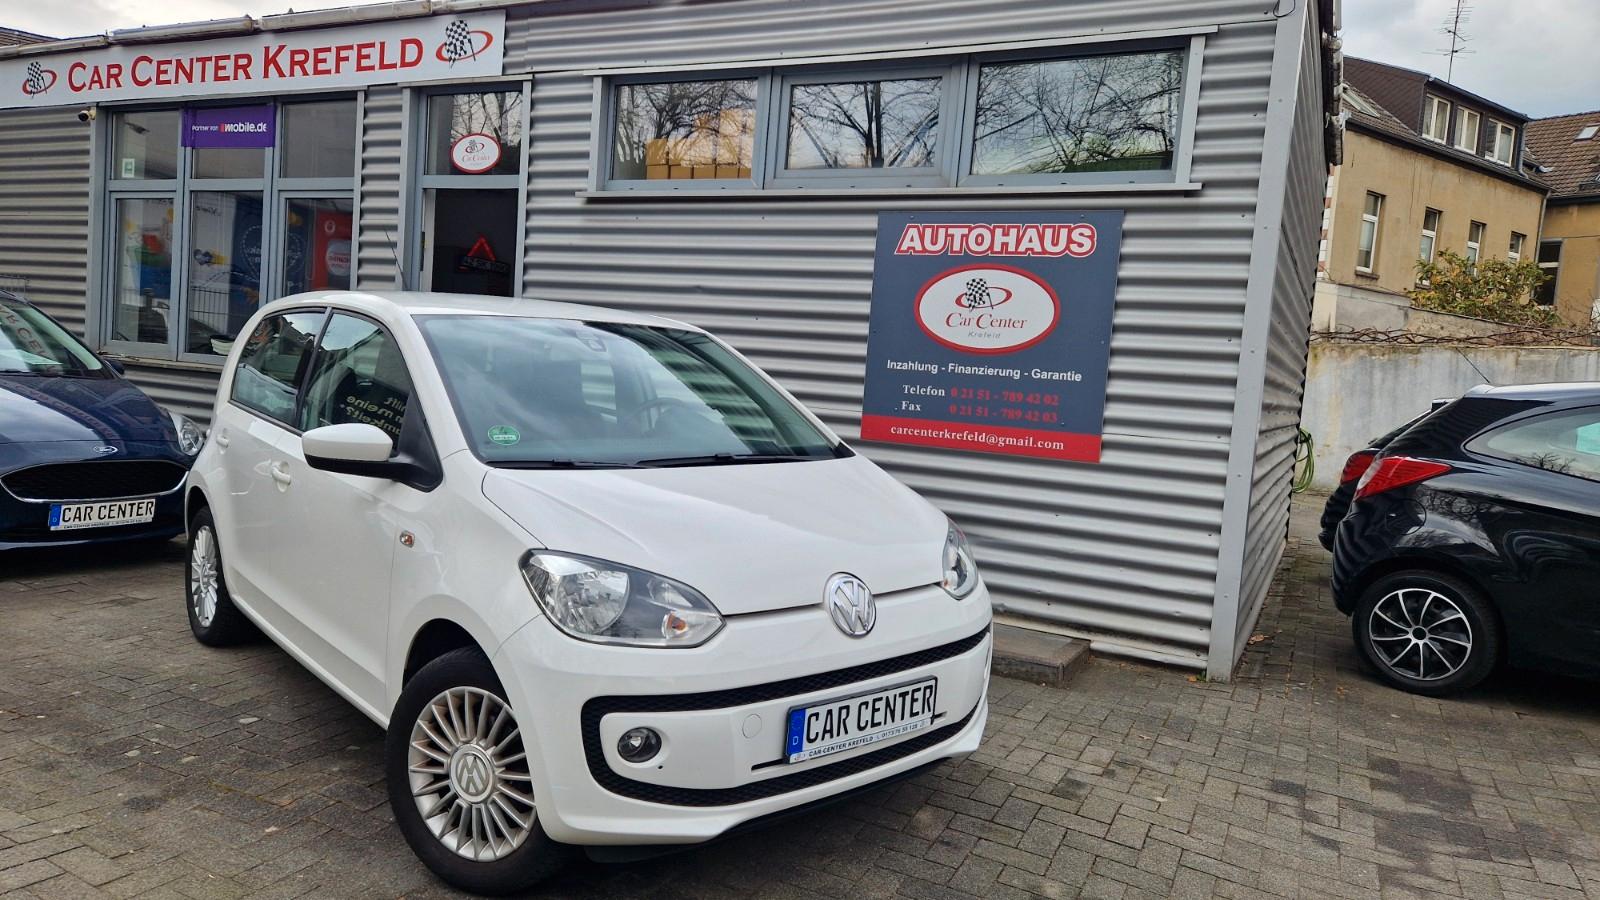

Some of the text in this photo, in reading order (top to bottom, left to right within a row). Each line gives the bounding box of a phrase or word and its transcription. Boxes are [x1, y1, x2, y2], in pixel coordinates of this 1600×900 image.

[67, 37, 424, 93] CAR CENTER KREFELD
[894, 223, 1097, 258] AUTOHAUS
[945, 312, 1028, 330] Car Center
[886, 359, 938, 374] Inzahlung
[948, 363, 1021, 380] Finanzierung
[1031, 368, 1083, 382] Garantie
[902, 384, 946, 397] Telefon
[901, 401, 922, 412] Fax
[890, 425, 1065, 451] carcenterkrefeld@gmail.com
[62, 502, 153, 522] CAR CENTER
[806, 685, 933, 744] CAR CENTER
[792, 735, 799, 746] D
[808, 749, 822, 757] CAR
[822, 742, 848, 754] CENTER
